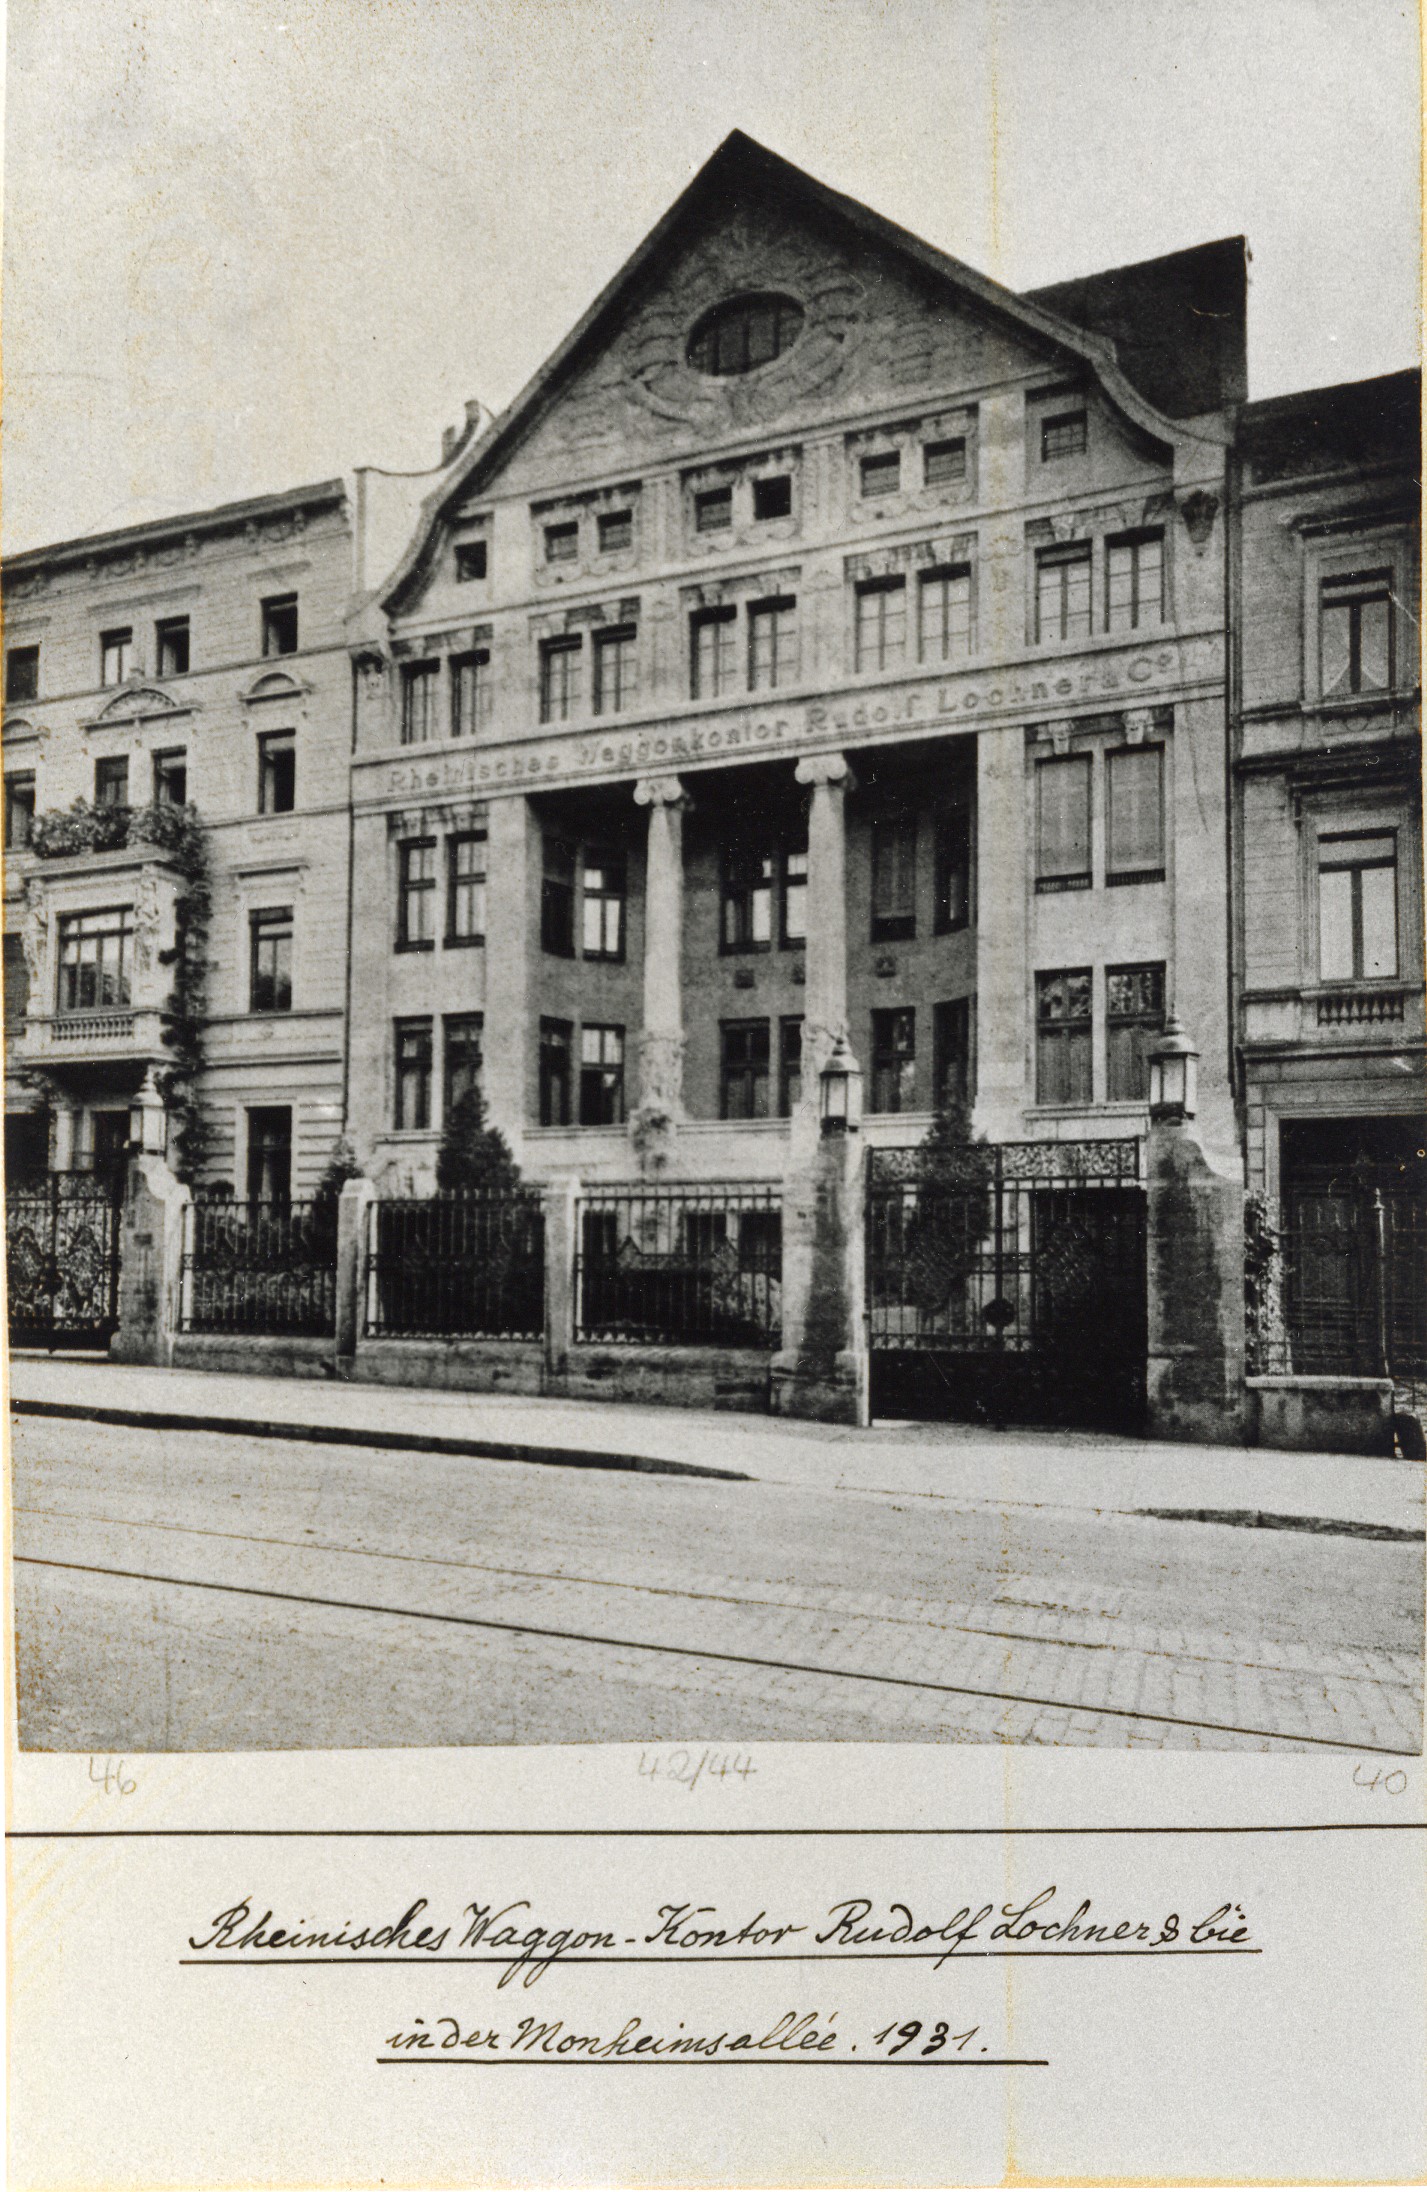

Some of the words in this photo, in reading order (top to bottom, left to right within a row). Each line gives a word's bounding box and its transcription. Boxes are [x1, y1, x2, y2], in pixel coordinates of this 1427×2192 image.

[88, 1756, 137, 1796] 46
[638, 1749, 758, 1792] 42/44
[1352, 1763, 1407, 1795] 40
[188, 1895, 452, 1951] Rheinisches
[815, 1898, 993, 1970] Rudolf
[990, 1885, 1150, 1942] Lochner
